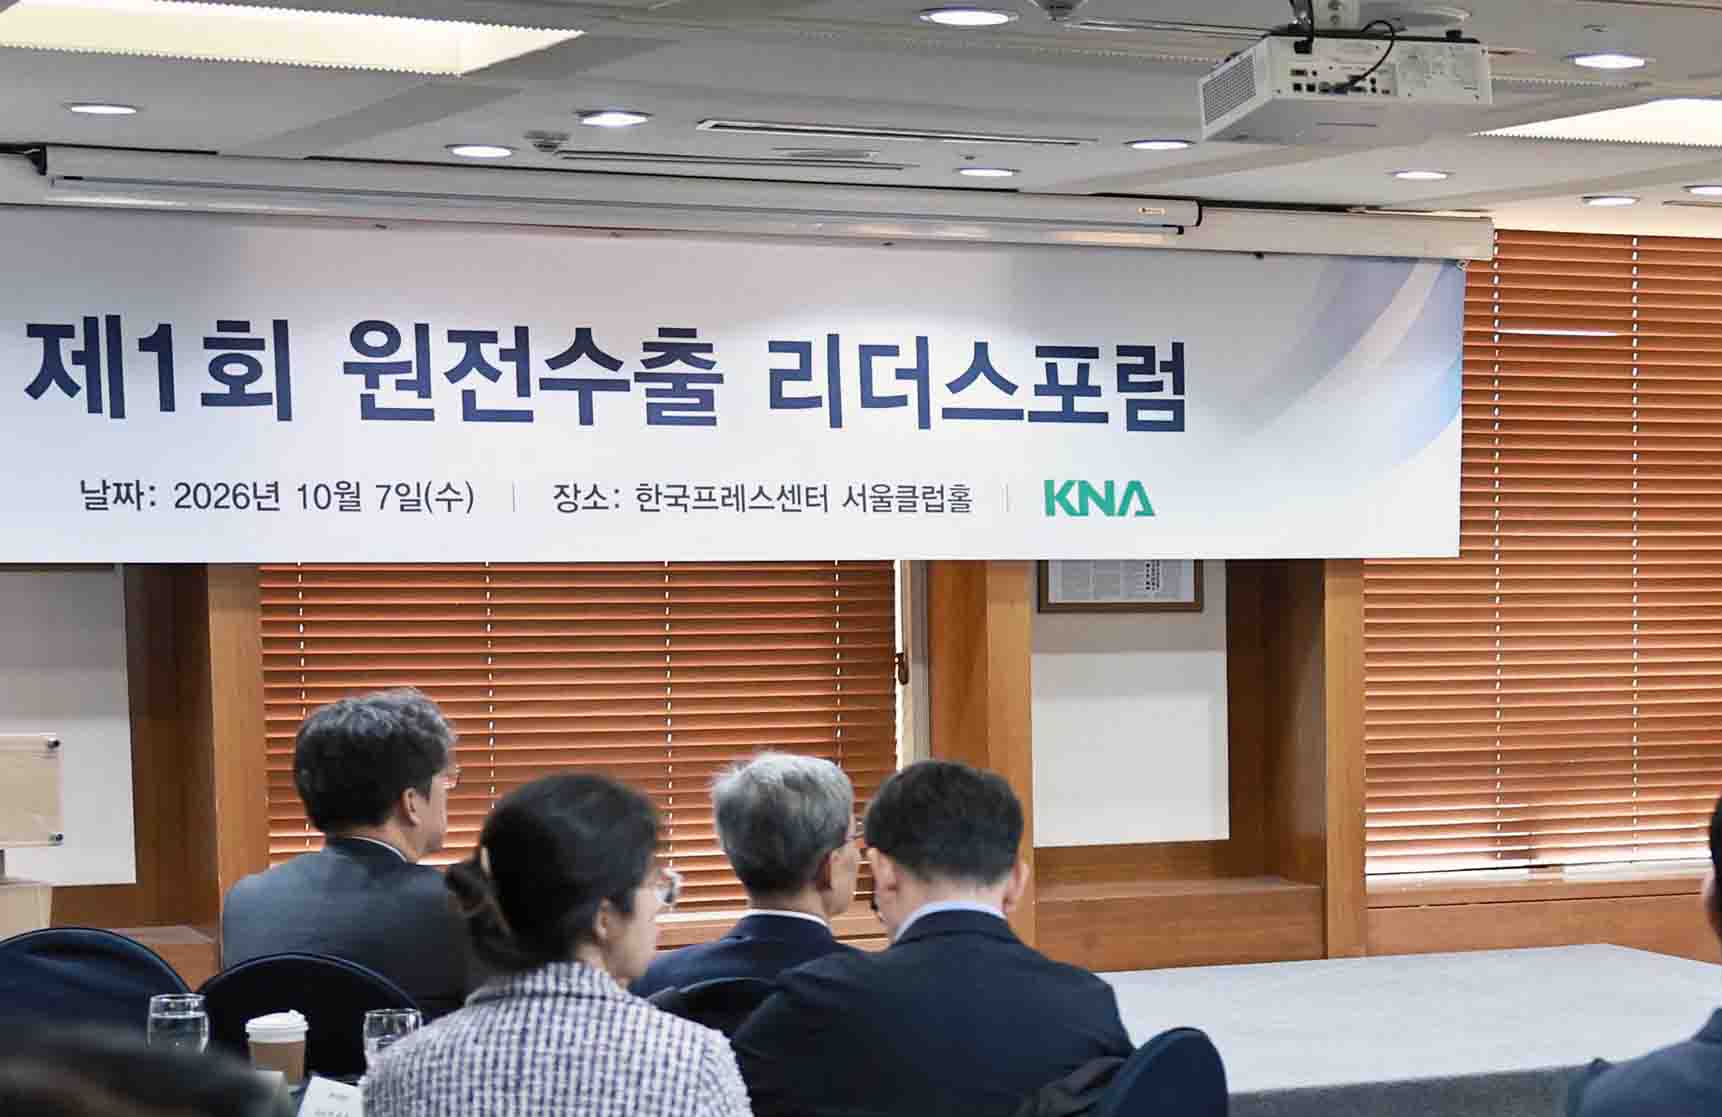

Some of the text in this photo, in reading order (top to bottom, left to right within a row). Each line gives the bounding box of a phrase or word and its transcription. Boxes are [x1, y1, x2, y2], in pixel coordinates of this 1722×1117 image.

[23, 313, 1186, 433] 제1회 원전수출 리더스포럼
[79, 480, 475, 516] 날짜: 2026년 10월 7일(수)
[552, 483, 974, 516] 장소: 한국프레스센터 서울클럽홀
[1043, 479, 1156, 518] KNA
